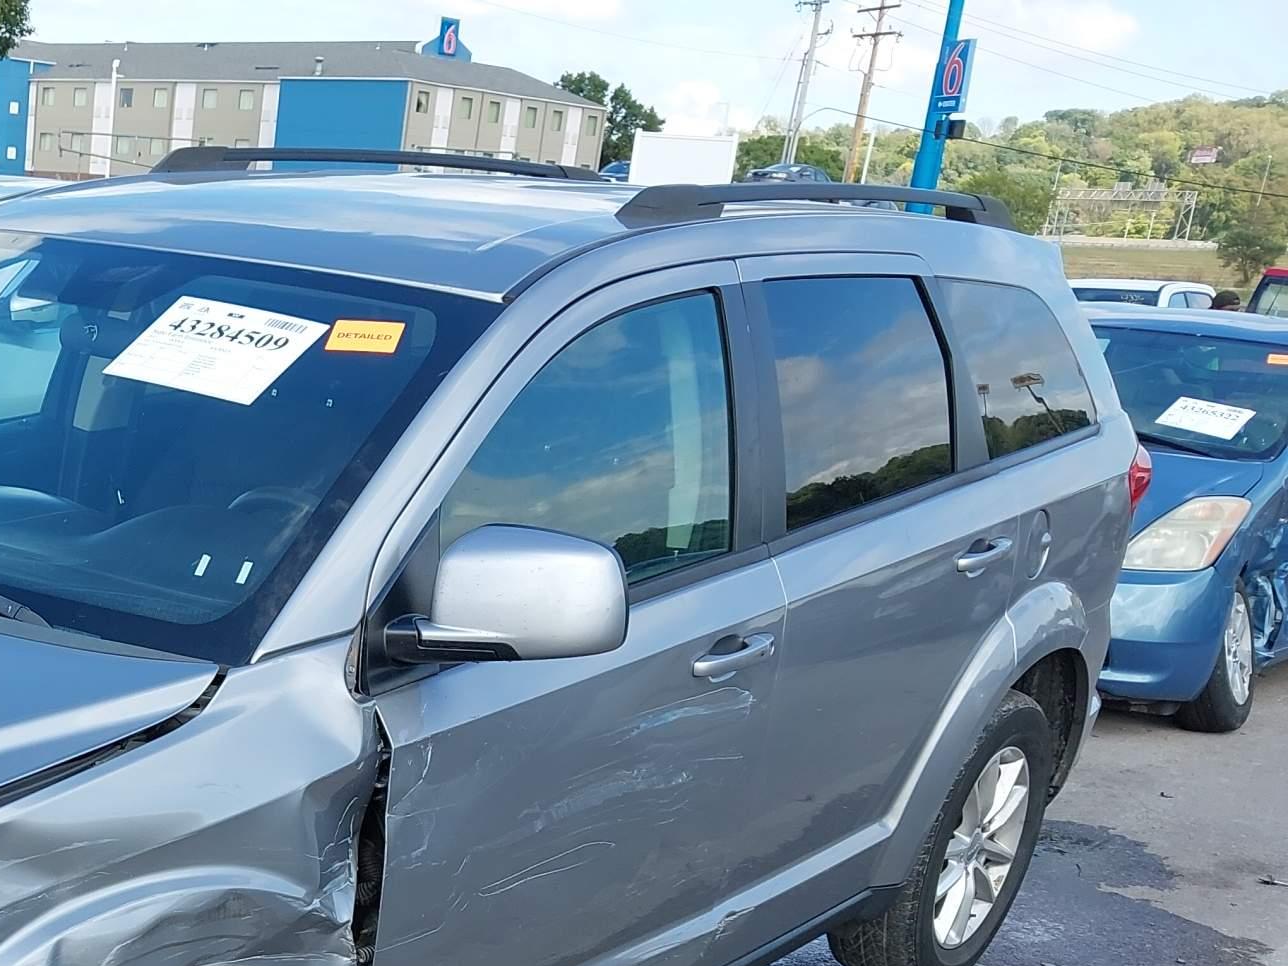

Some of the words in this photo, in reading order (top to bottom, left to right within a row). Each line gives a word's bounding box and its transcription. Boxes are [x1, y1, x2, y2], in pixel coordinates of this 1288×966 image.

[444, 24, 457, 55] 6
[943, 42, 965, 96] 6
[168, 316, 290, 352] 43284509
[336, 331, 394, 342] DETAILED
